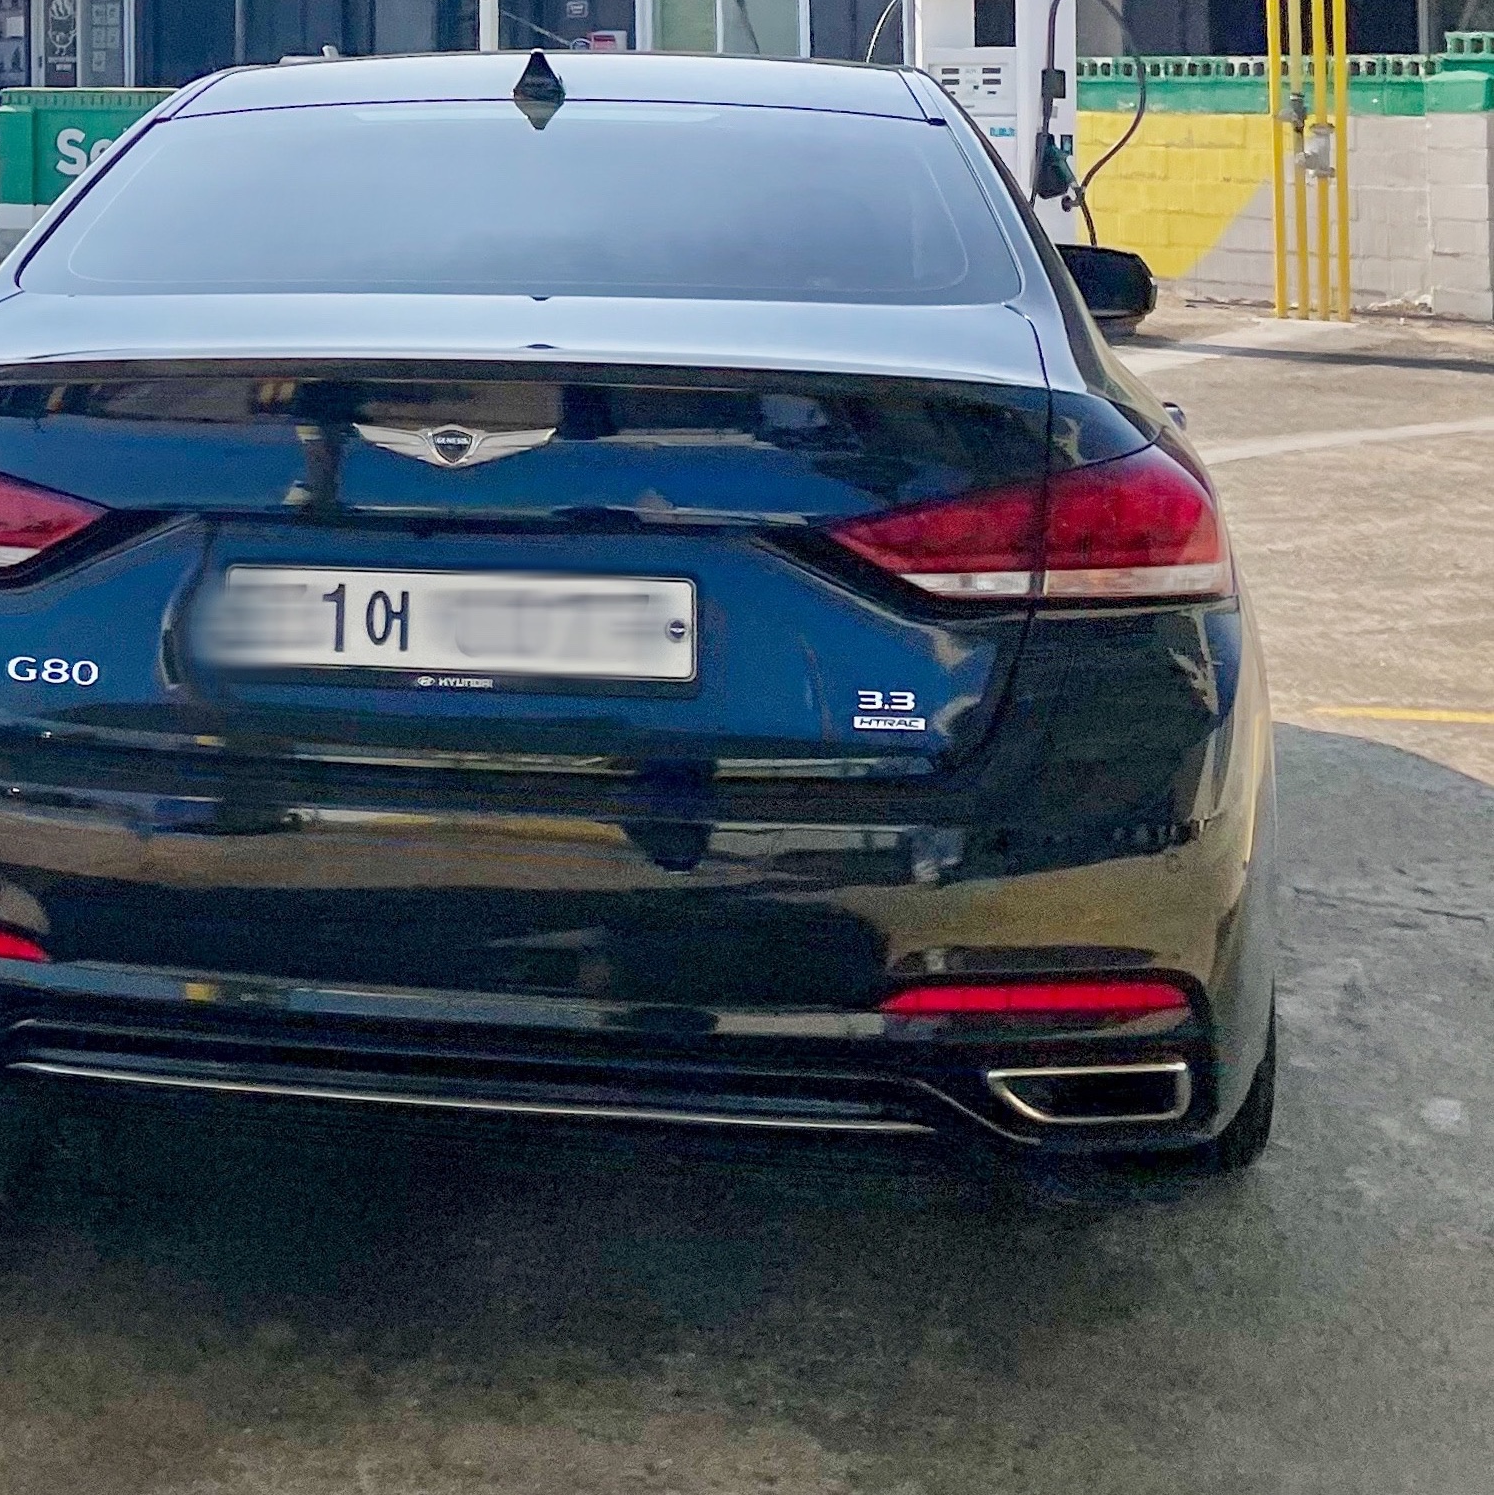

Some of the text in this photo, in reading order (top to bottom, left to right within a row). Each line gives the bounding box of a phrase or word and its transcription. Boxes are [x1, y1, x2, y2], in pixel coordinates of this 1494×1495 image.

[7, 655, 99, 686] G80
[438, 677, 494, 688] HYUNDAI
[857, 690, 916, 711] 3.3
[859, 717, 921, 729] HTRAC
